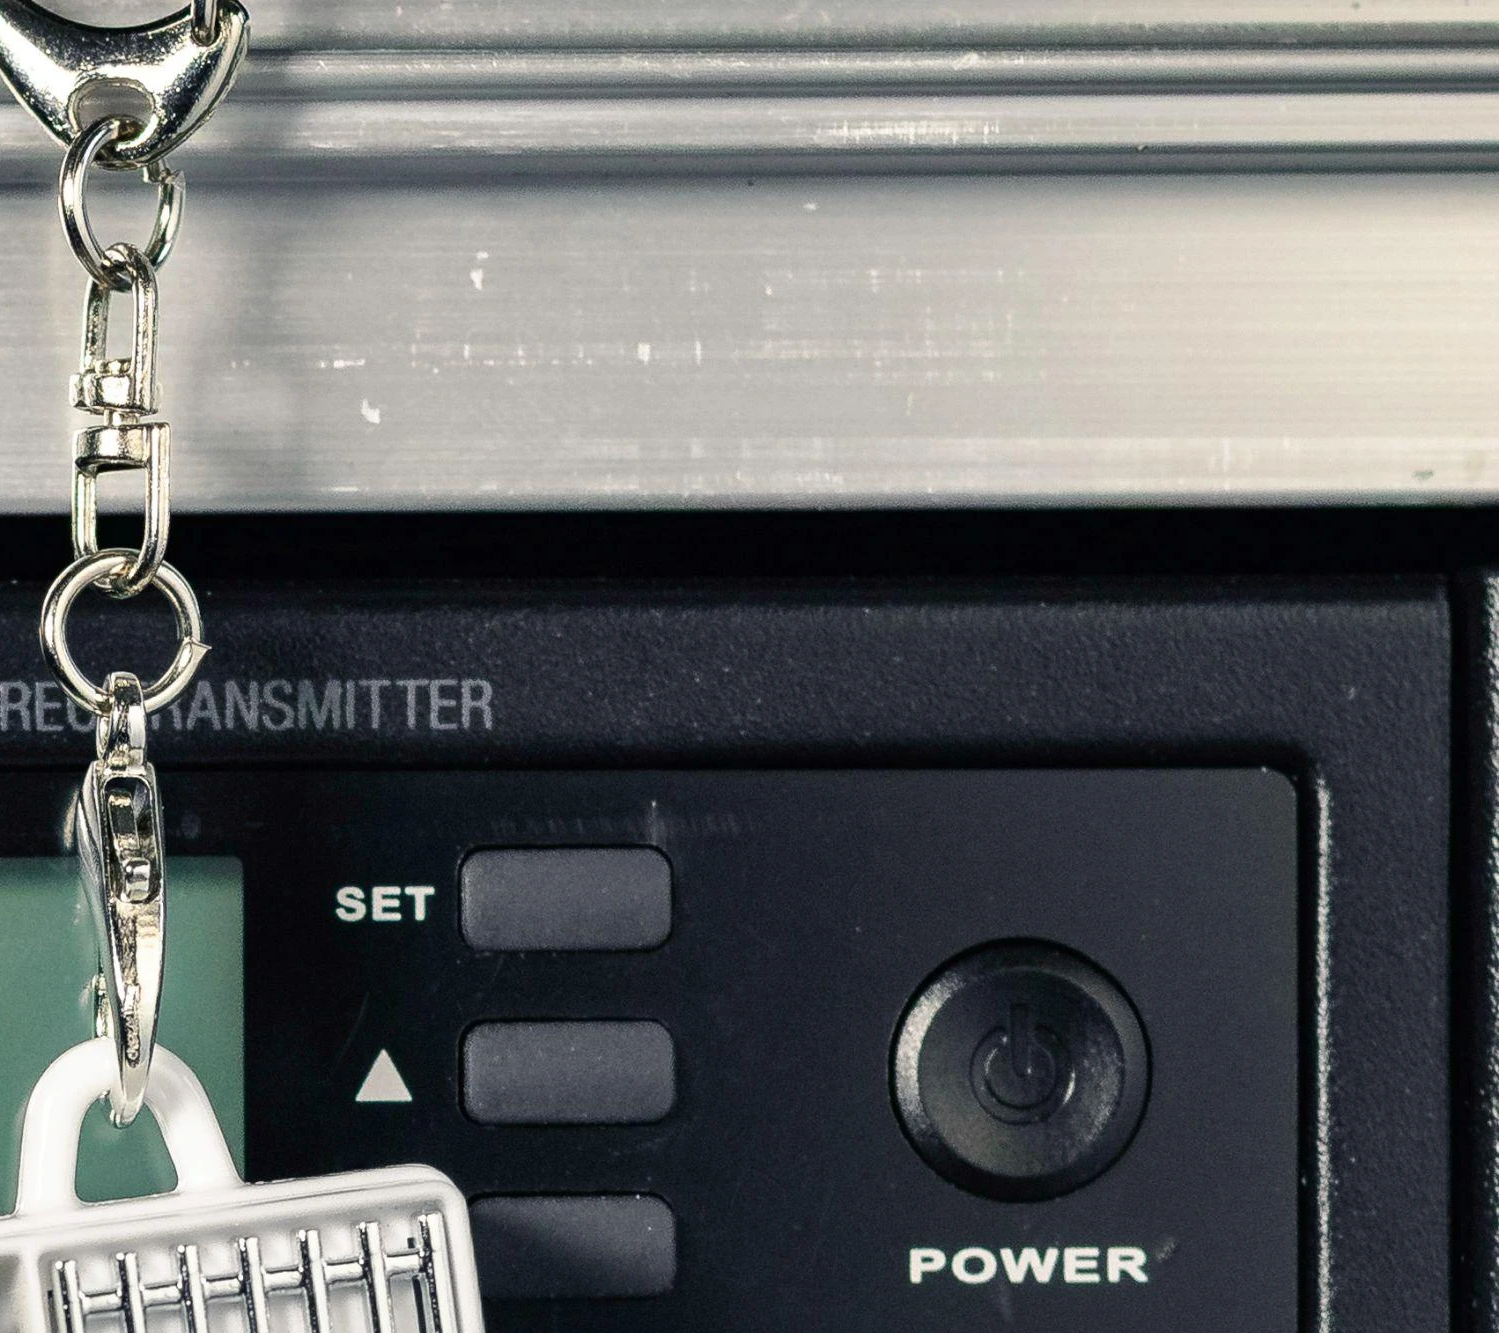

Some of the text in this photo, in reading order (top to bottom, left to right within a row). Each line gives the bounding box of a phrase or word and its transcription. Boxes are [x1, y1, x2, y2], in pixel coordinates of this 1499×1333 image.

[141, 679, 495, 732] ANSMITTER
[335, 885, 436, 922] SET
[909, 1246, 1148, 1284] POWER
